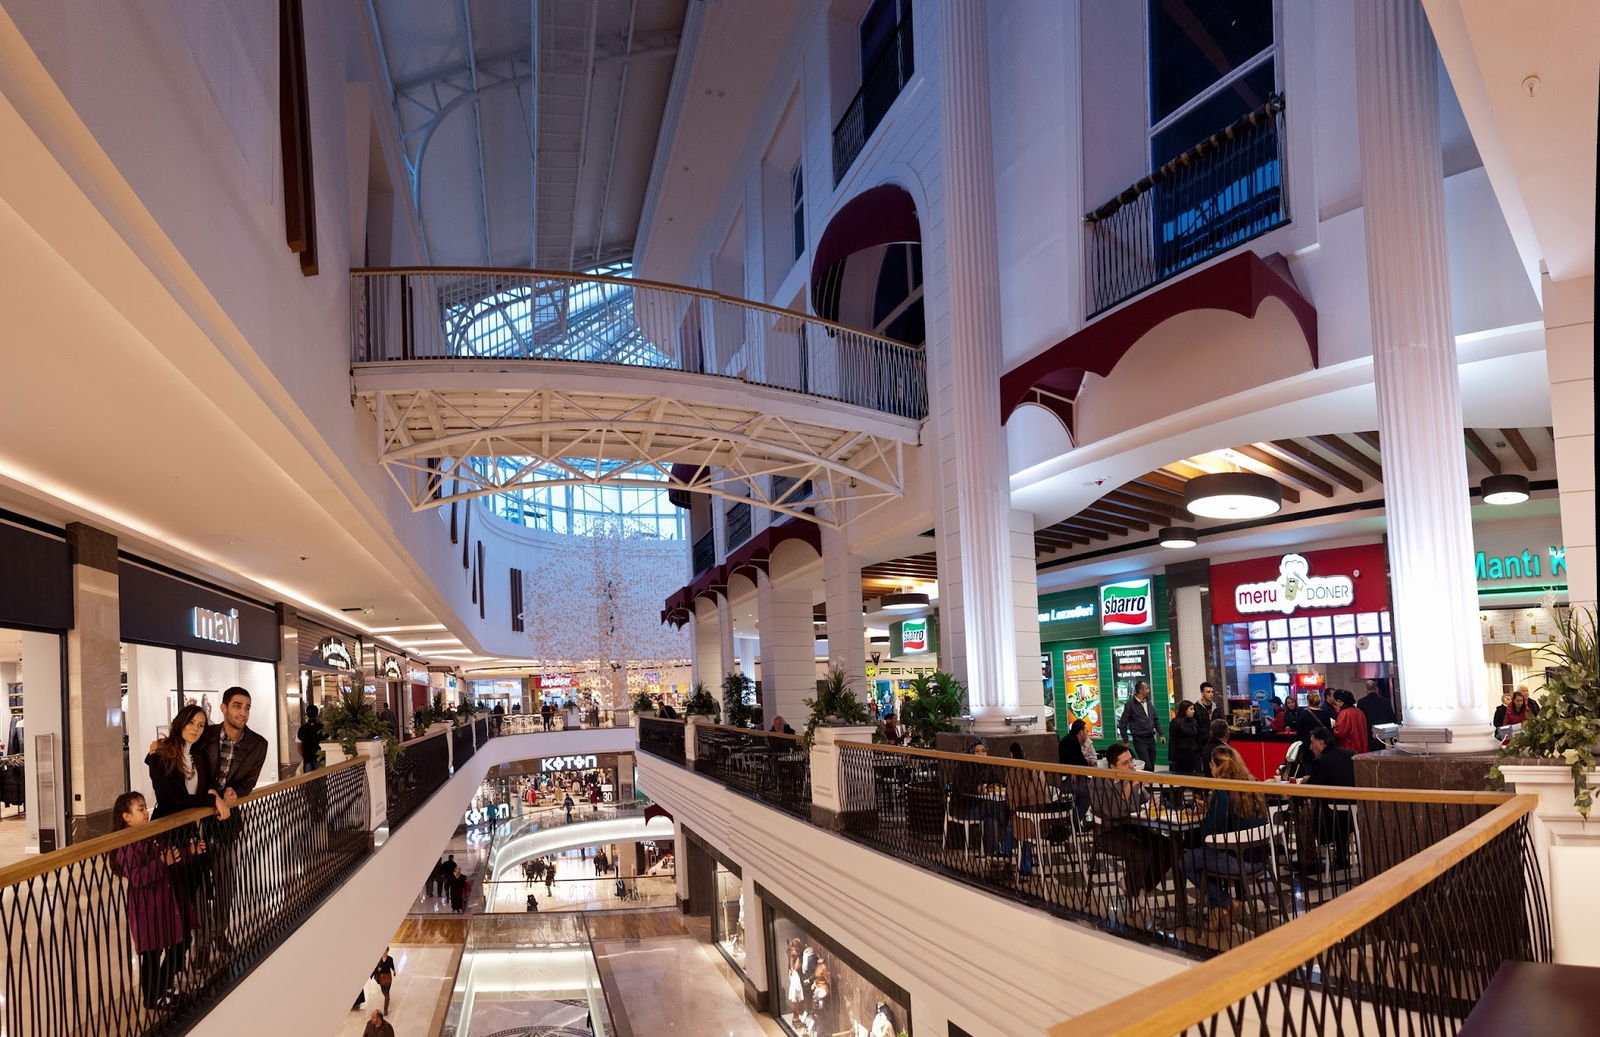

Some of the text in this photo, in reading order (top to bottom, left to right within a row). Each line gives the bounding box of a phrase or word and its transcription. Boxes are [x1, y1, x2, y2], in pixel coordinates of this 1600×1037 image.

[1104, 594, 1146, 615] sbarro
[1238, 583, 1349, 605] meru DÖNER
[194, 606, 240, 646] mavi
[904, 628, 924, 642] sbarro
[541, 755, 598, 772] KOTON
